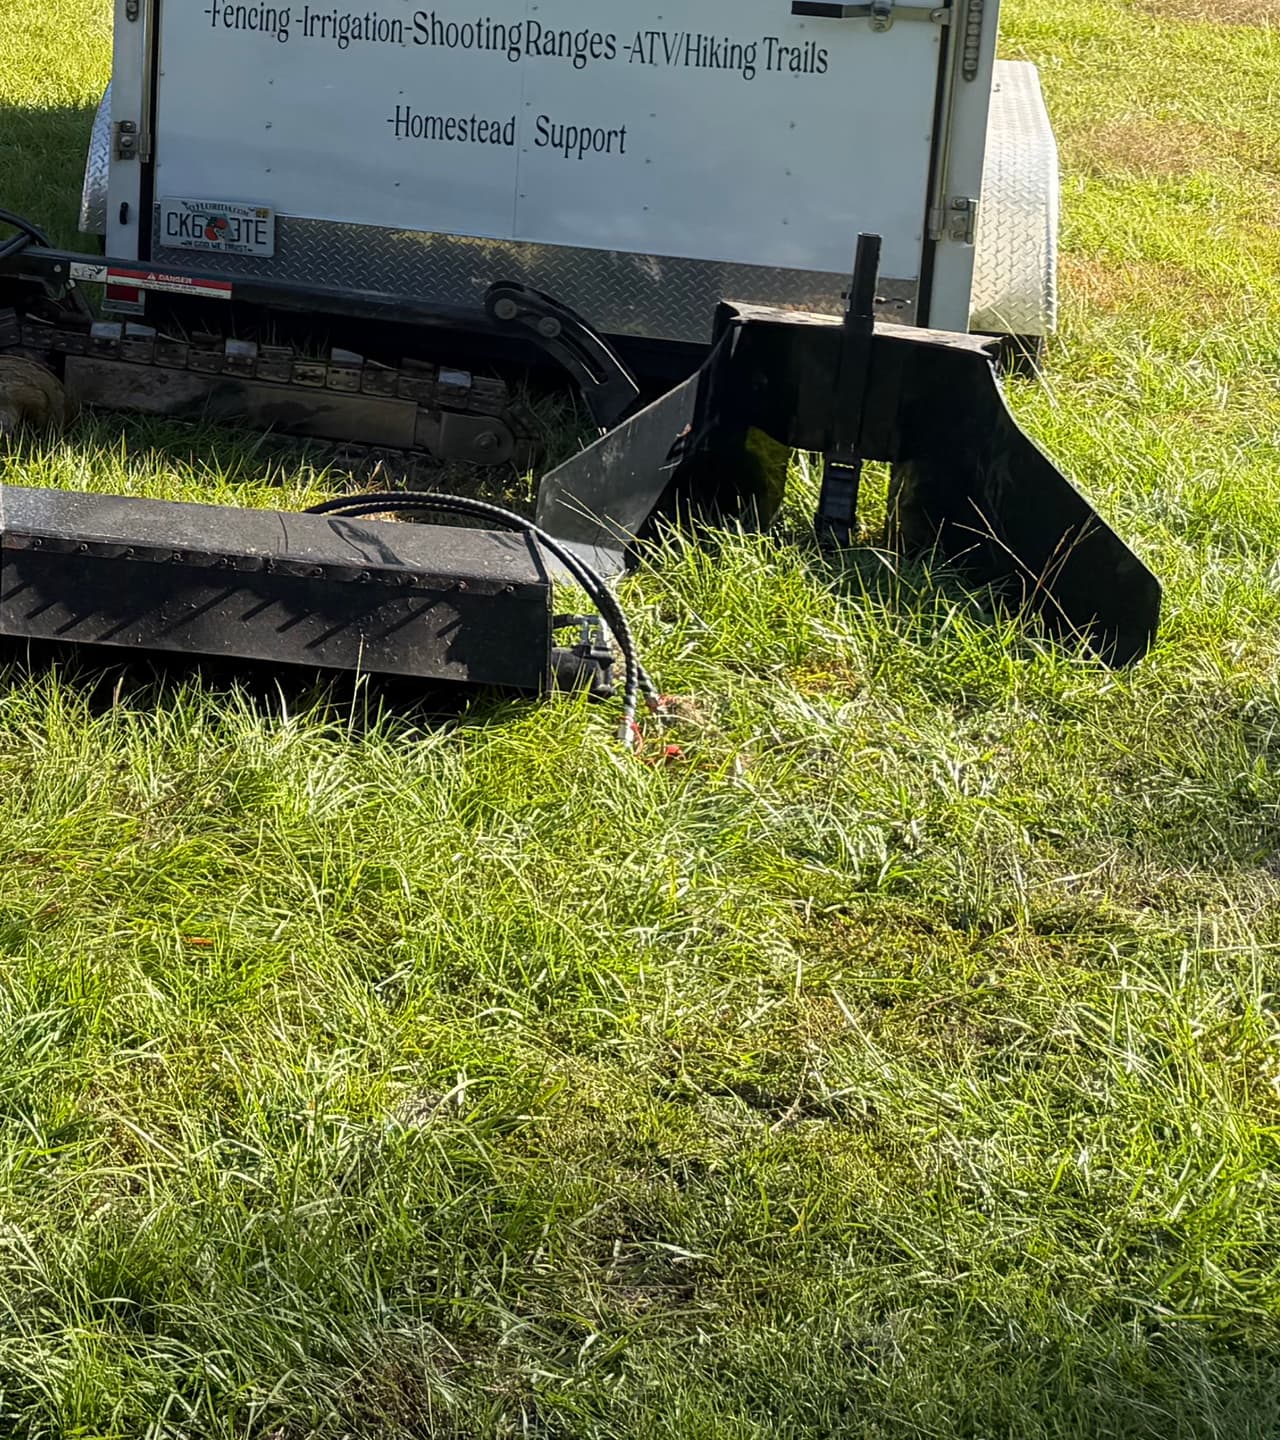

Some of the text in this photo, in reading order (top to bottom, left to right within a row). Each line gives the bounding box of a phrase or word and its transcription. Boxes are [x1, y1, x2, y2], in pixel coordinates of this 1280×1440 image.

[762, 36, 829, 74] Trails
[534, 114, 627, 160] Support
[158, 273, 193, 284] DANGER
